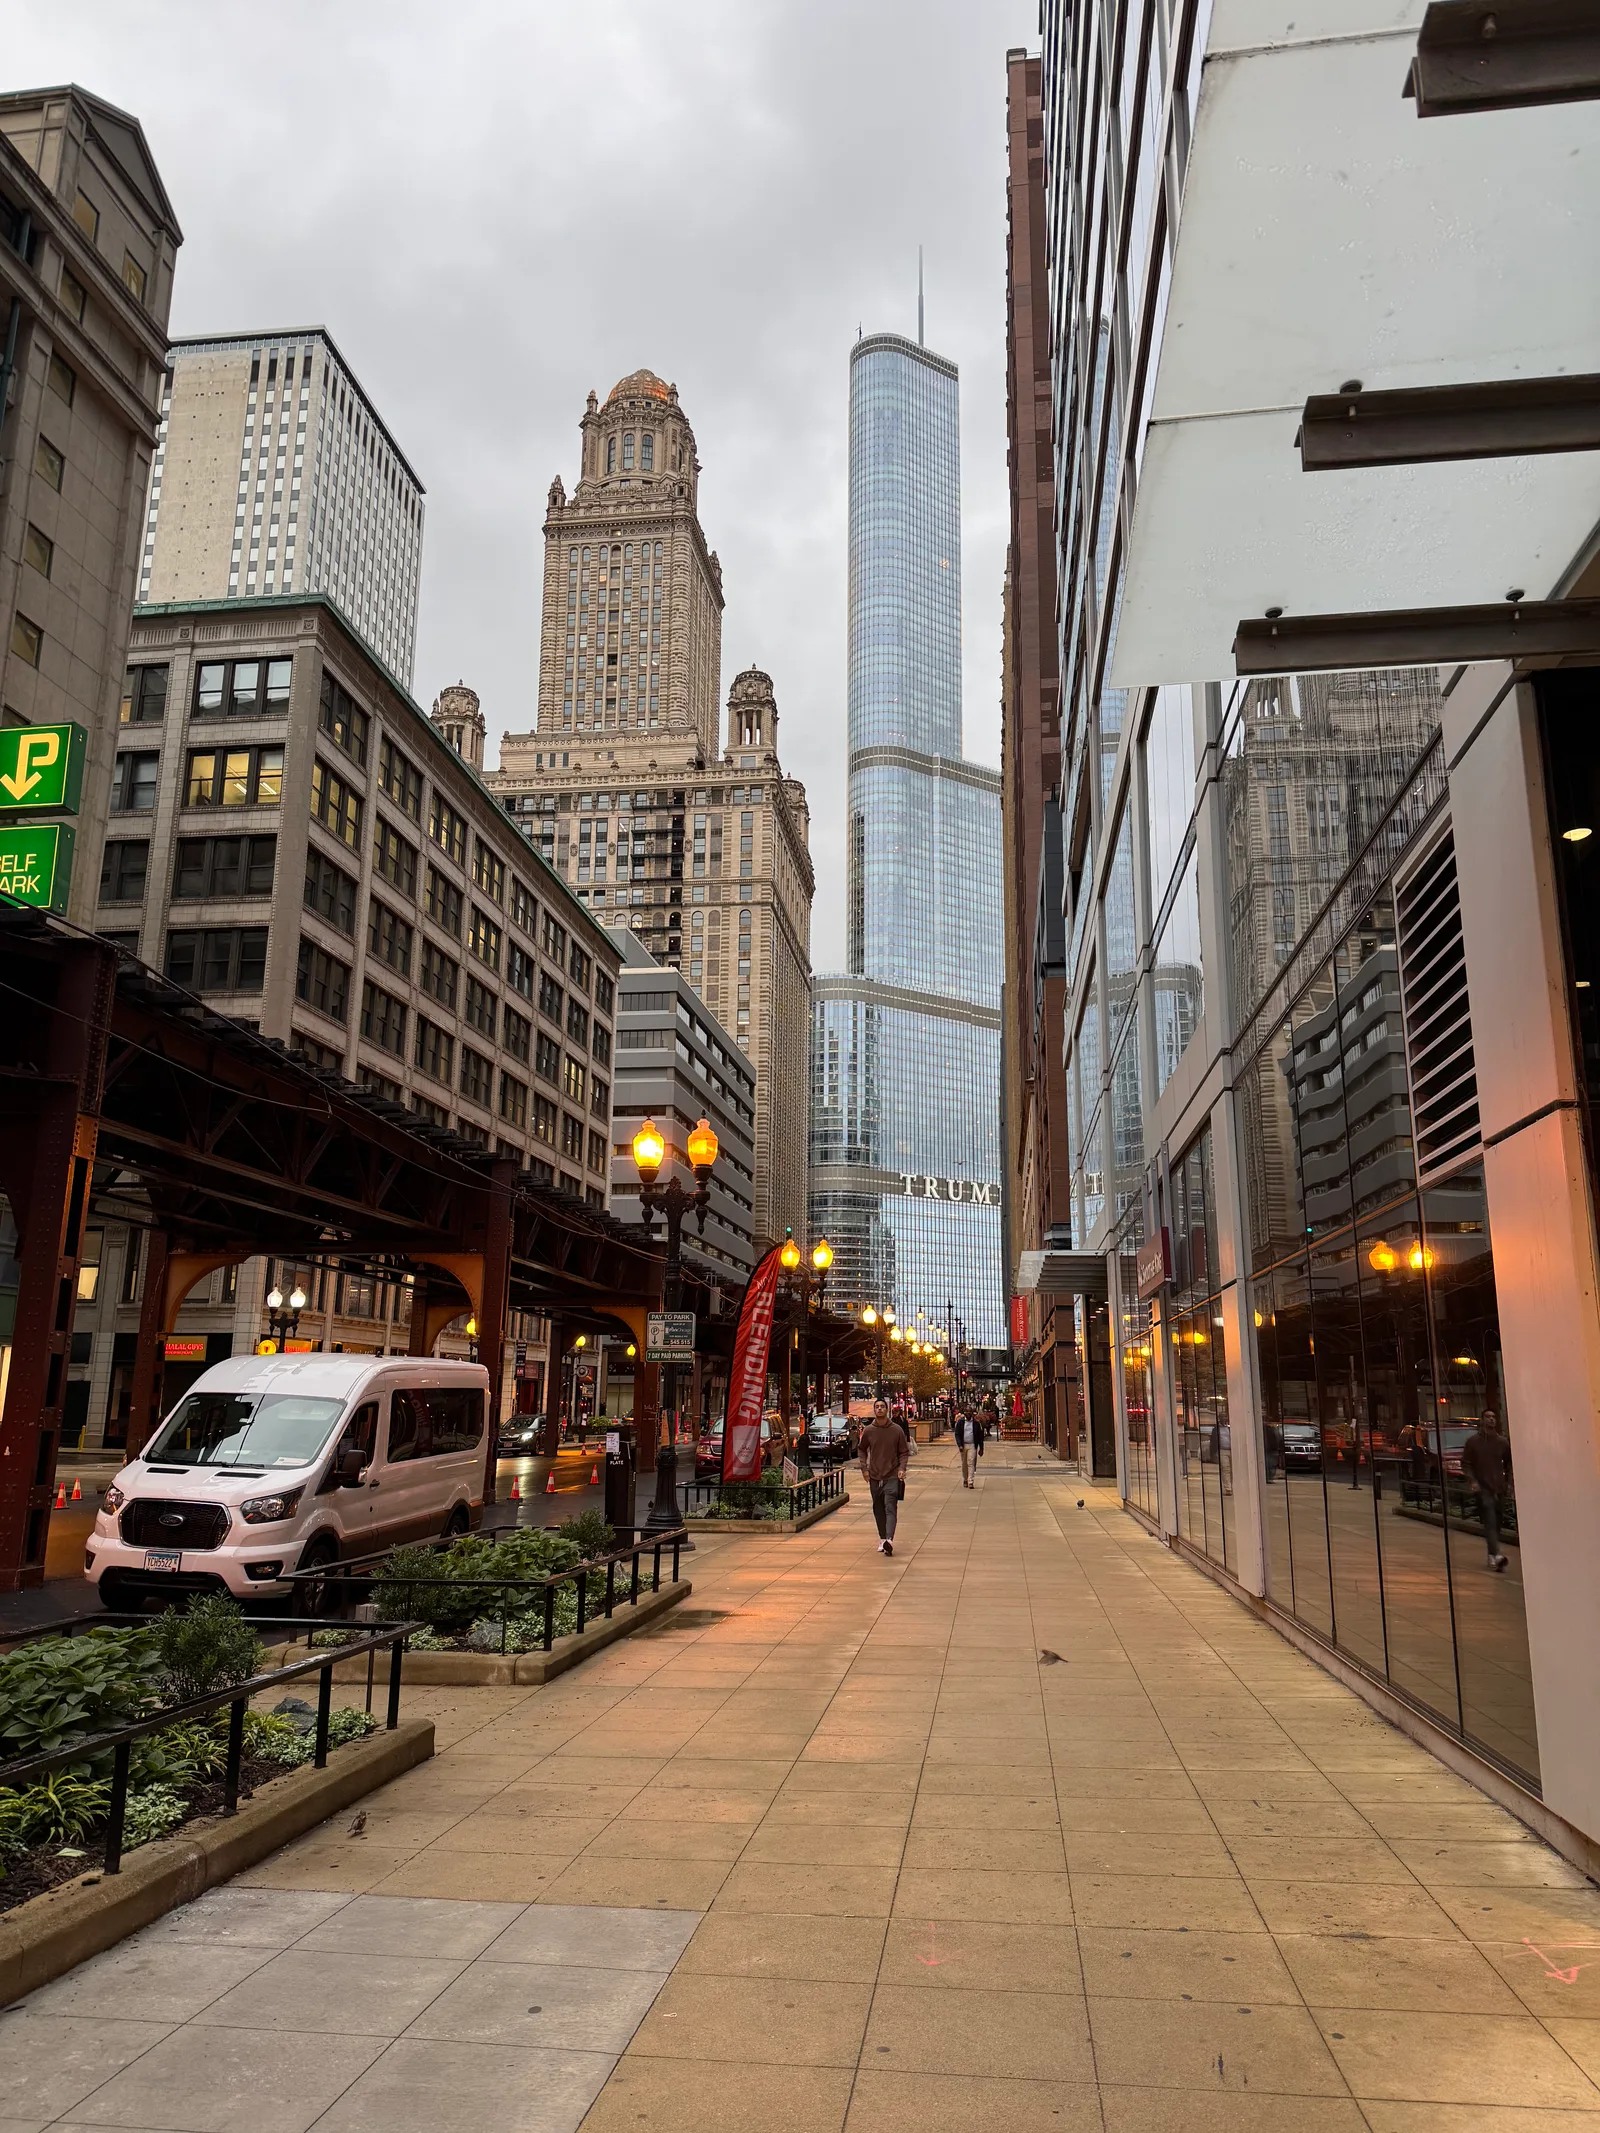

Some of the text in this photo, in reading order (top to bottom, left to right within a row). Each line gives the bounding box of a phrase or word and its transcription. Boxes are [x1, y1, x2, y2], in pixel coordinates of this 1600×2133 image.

[0, 853, 37, 873] ELF
[899, 1172, 1002, 1206] TRUM
[187, 1343, 204, 1351] GUYS
[738, 1291, 773, 1421] BLENDING
